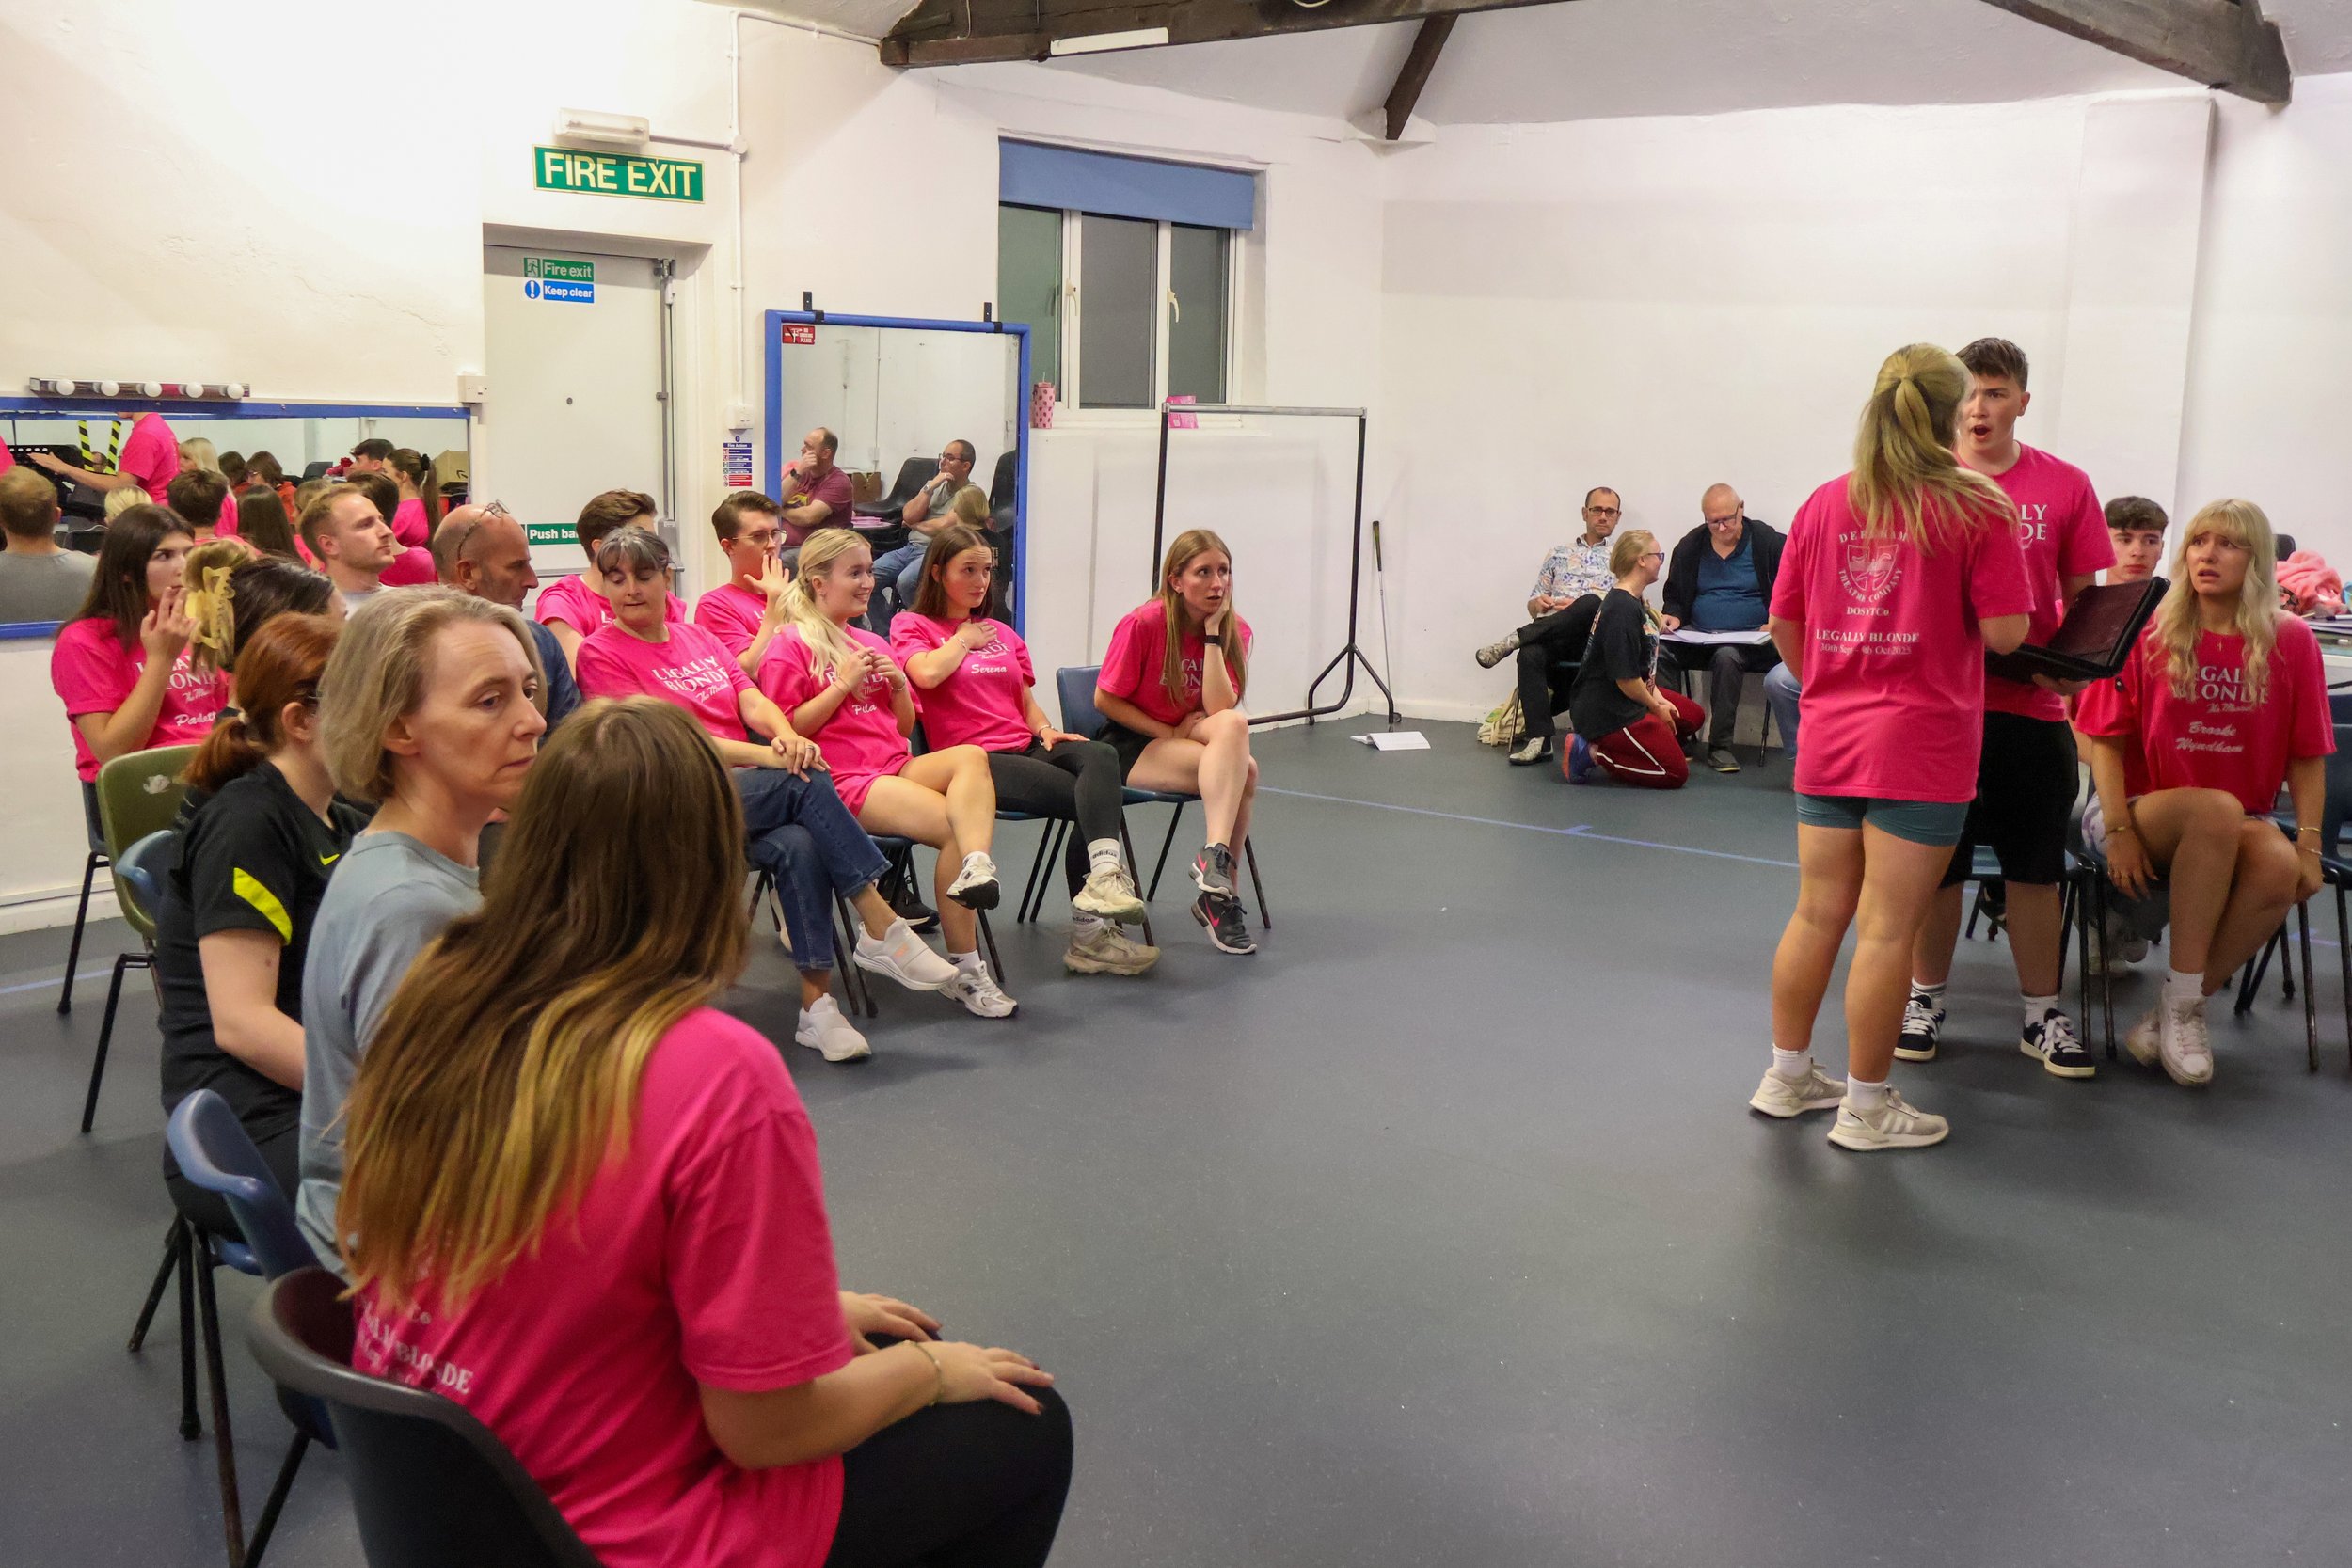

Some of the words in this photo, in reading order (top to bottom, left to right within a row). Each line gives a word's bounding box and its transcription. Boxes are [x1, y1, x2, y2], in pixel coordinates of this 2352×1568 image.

[544, 151, 617, 190] FIRE
[627, 160, 697, 197] EXIT
[544, 262, 567, 276] Fire
[569, 265, 592, 277] exit
[544, 285, 568, 298] Keep
[569, 287, 593, 298] clear
[529, 528, 559, 540] Push
[1868, 568, 1902, 602] COMPANY
[1816, 629, 1865, 642] LEGALLY
[1869, 632, 1919, 643] BLONDE
[652, 656, 719, 680] LEGALLY
[971, 663, 1008, 674] Serena
[664, 666, 729, 692] BLONDE
[2188, 721, 2237, 736] Brooke
[1091, 849, 1118, 859] adidas
